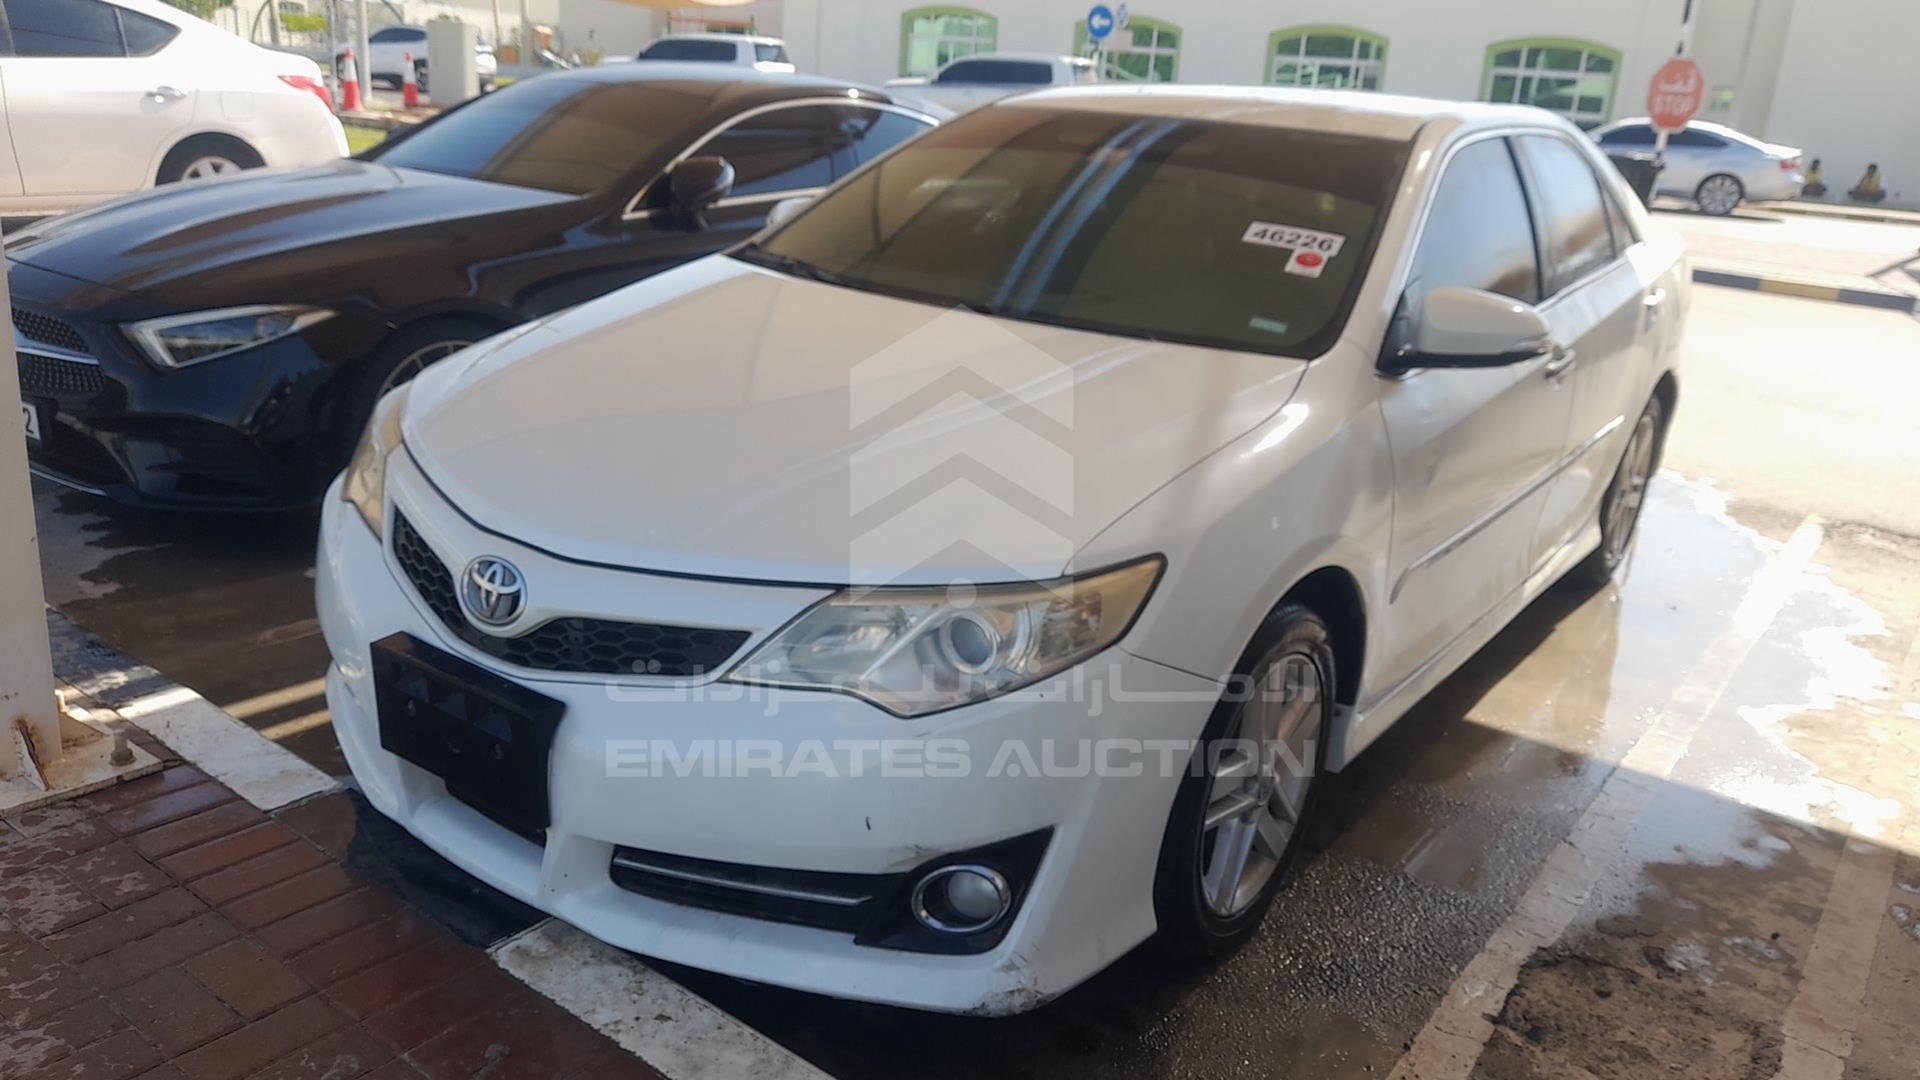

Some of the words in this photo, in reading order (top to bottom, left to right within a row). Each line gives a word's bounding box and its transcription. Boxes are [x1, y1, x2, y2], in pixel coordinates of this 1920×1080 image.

[1659, 67, 1698, 94] قف
[1654, 93, 1696, 116] STOP
[1253, 227, 1335, 253] 46226
